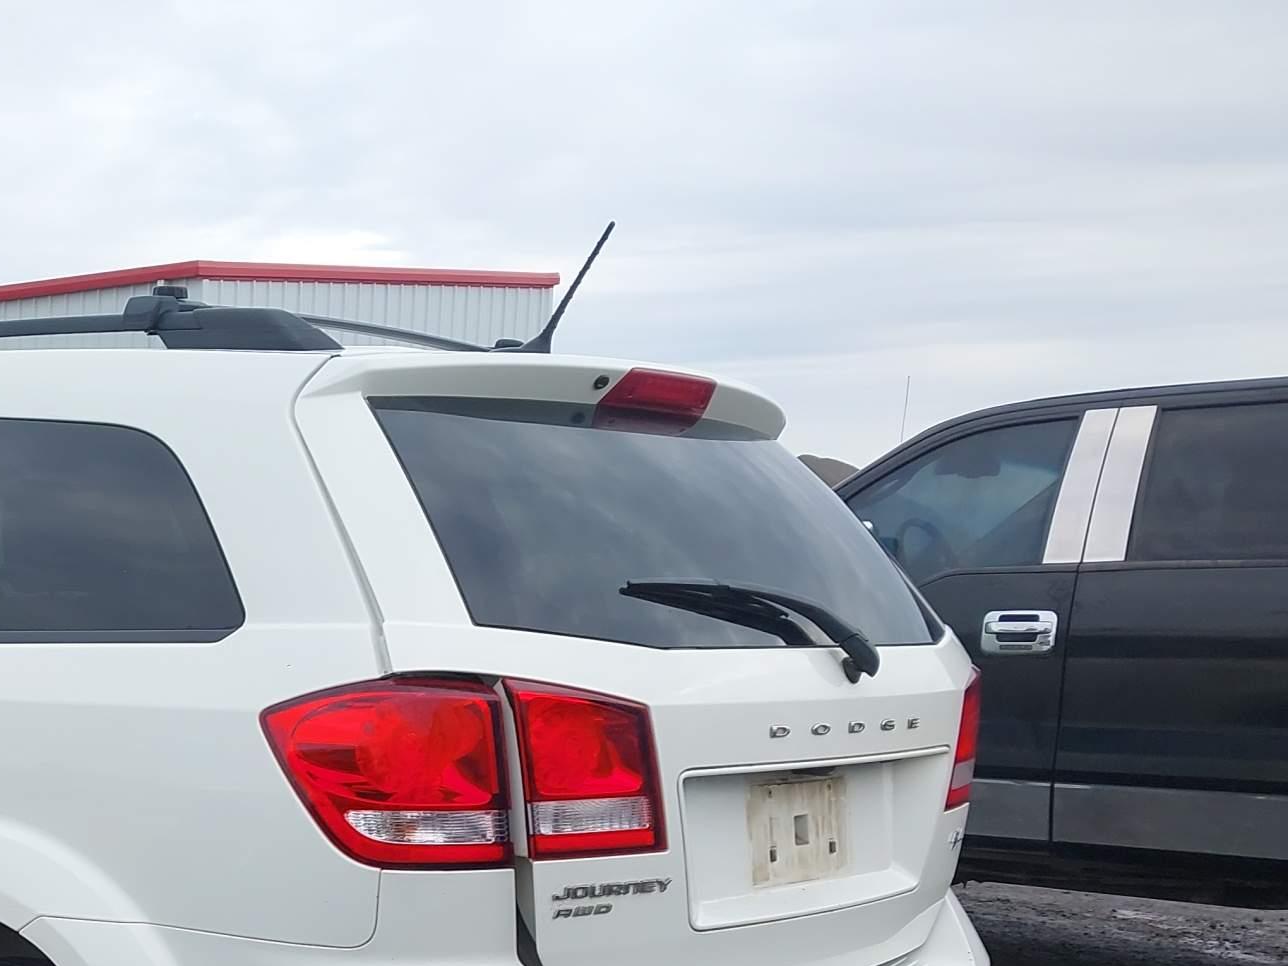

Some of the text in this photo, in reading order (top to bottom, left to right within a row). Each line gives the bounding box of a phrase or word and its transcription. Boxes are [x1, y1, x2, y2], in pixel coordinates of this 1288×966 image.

[769, 718, 921, 738] DODGE
[551, 877, 672, 901] JOURNEY
[551, 902, 613, 919] AWD
